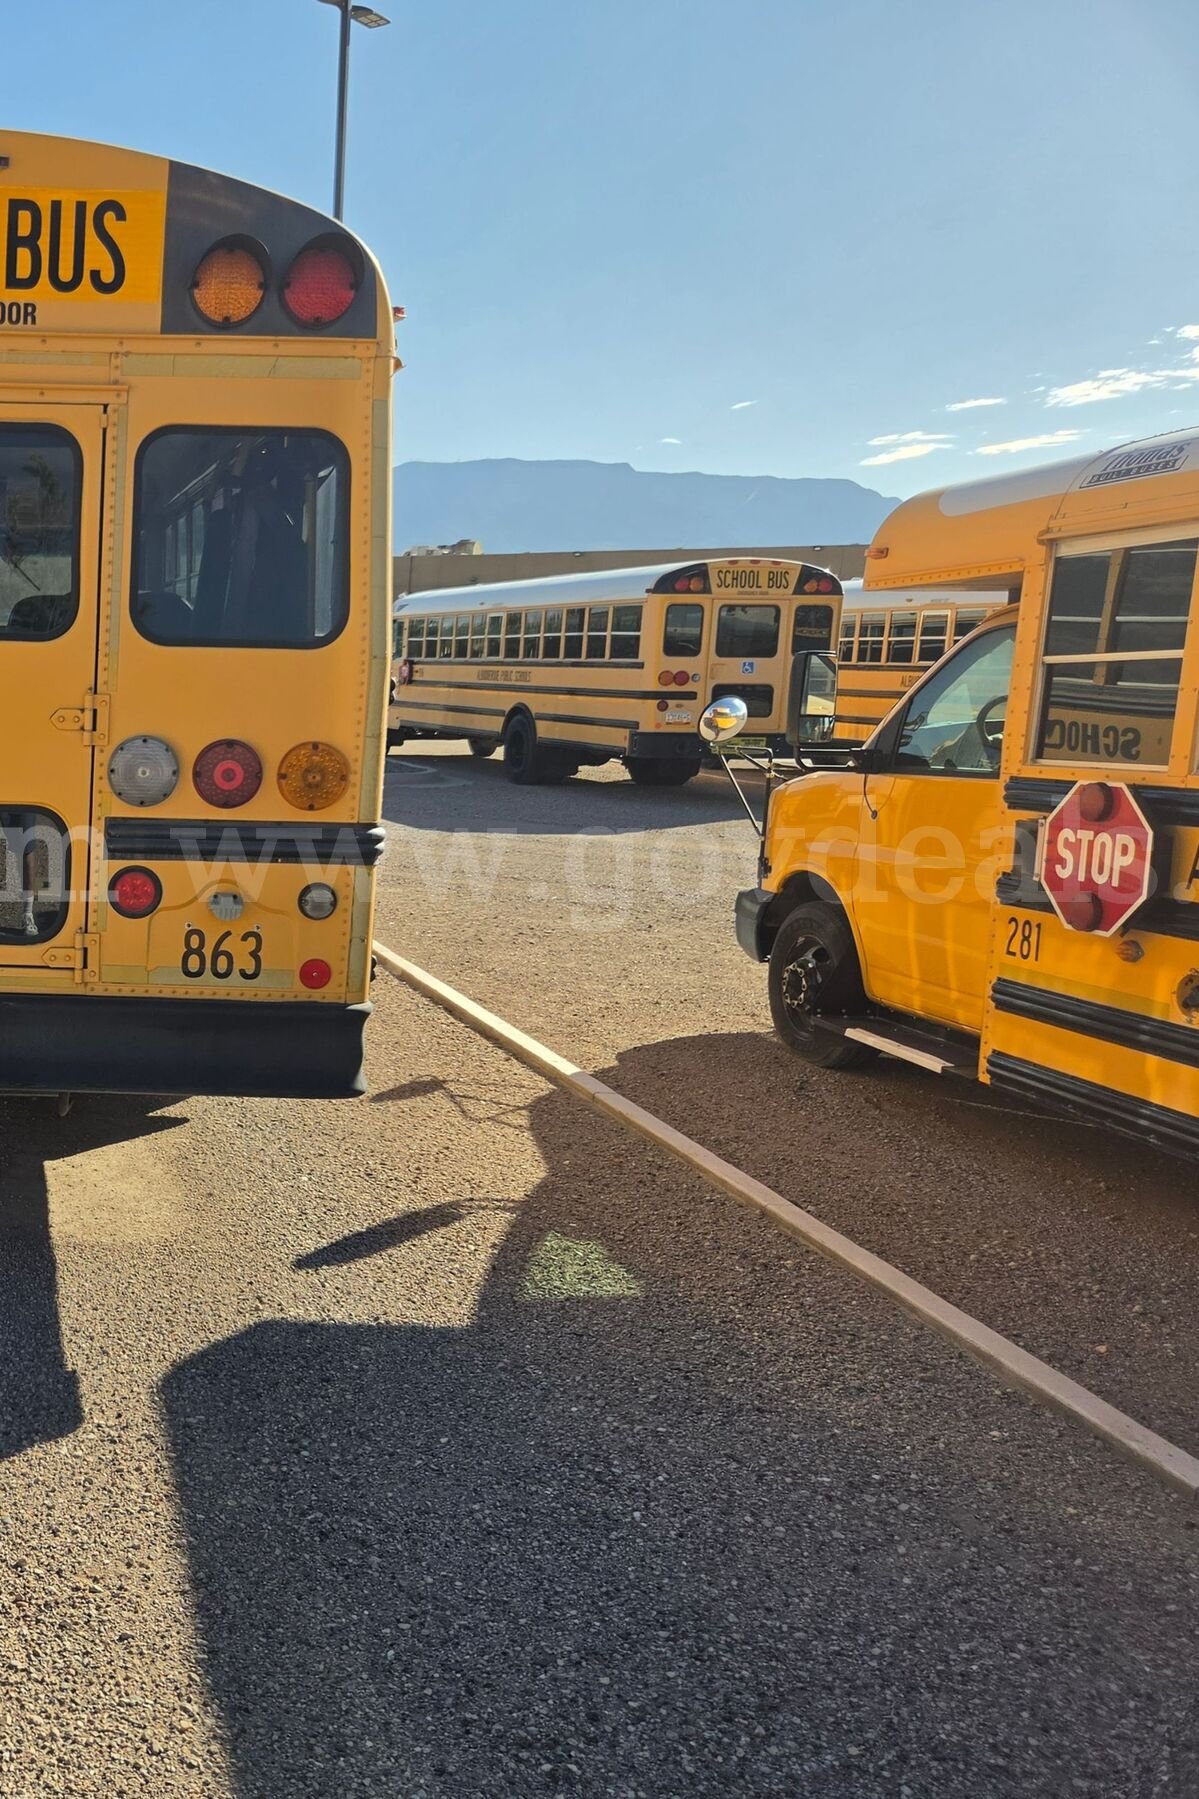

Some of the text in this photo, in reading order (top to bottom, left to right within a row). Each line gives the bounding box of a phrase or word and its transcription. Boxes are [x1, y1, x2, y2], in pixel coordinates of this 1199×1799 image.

[5, 198, 127, 294] BUS
[1090, 459, 1177, 483] BUILT BUSES
[1102, 442, 1192, 471] Thomas
[716, 570, 790, 589] SCHOOL BUS
[1055, 828, 1136, 887] STOP
[181, 928, 263, 980] 863
[1005, 917, 1042, 962] 281
